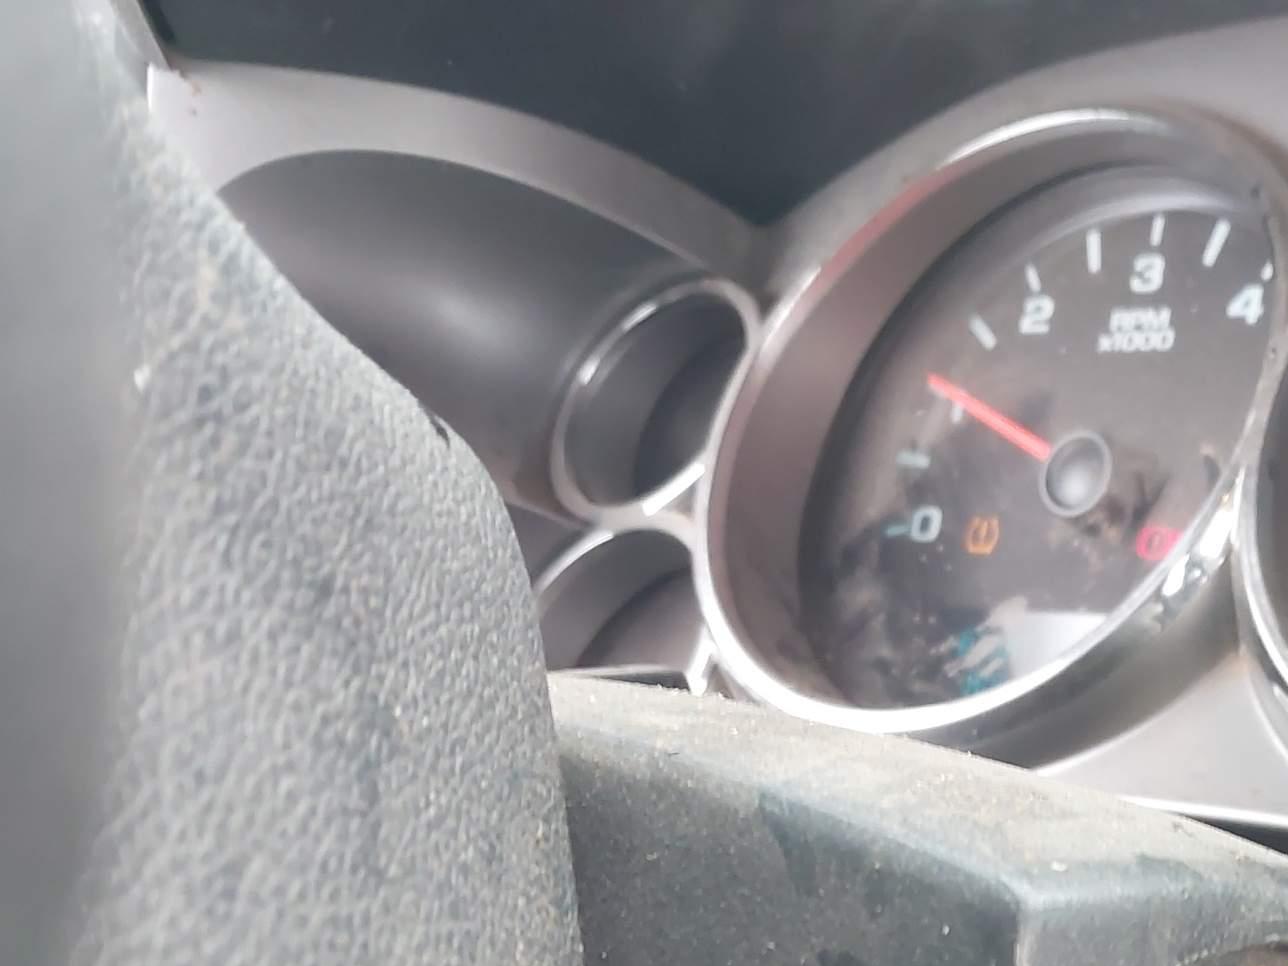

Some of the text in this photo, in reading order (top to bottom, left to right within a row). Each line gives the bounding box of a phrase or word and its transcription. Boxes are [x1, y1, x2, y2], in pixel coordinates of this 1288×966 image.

[1129, 251, 1166, 294] 3
[1020, 294, 1056, 335] 2
[1108, 306, 1172, 332] RPM
[1225, 282, 1265, 326] 4
[909, 504, 943, 543] 0
